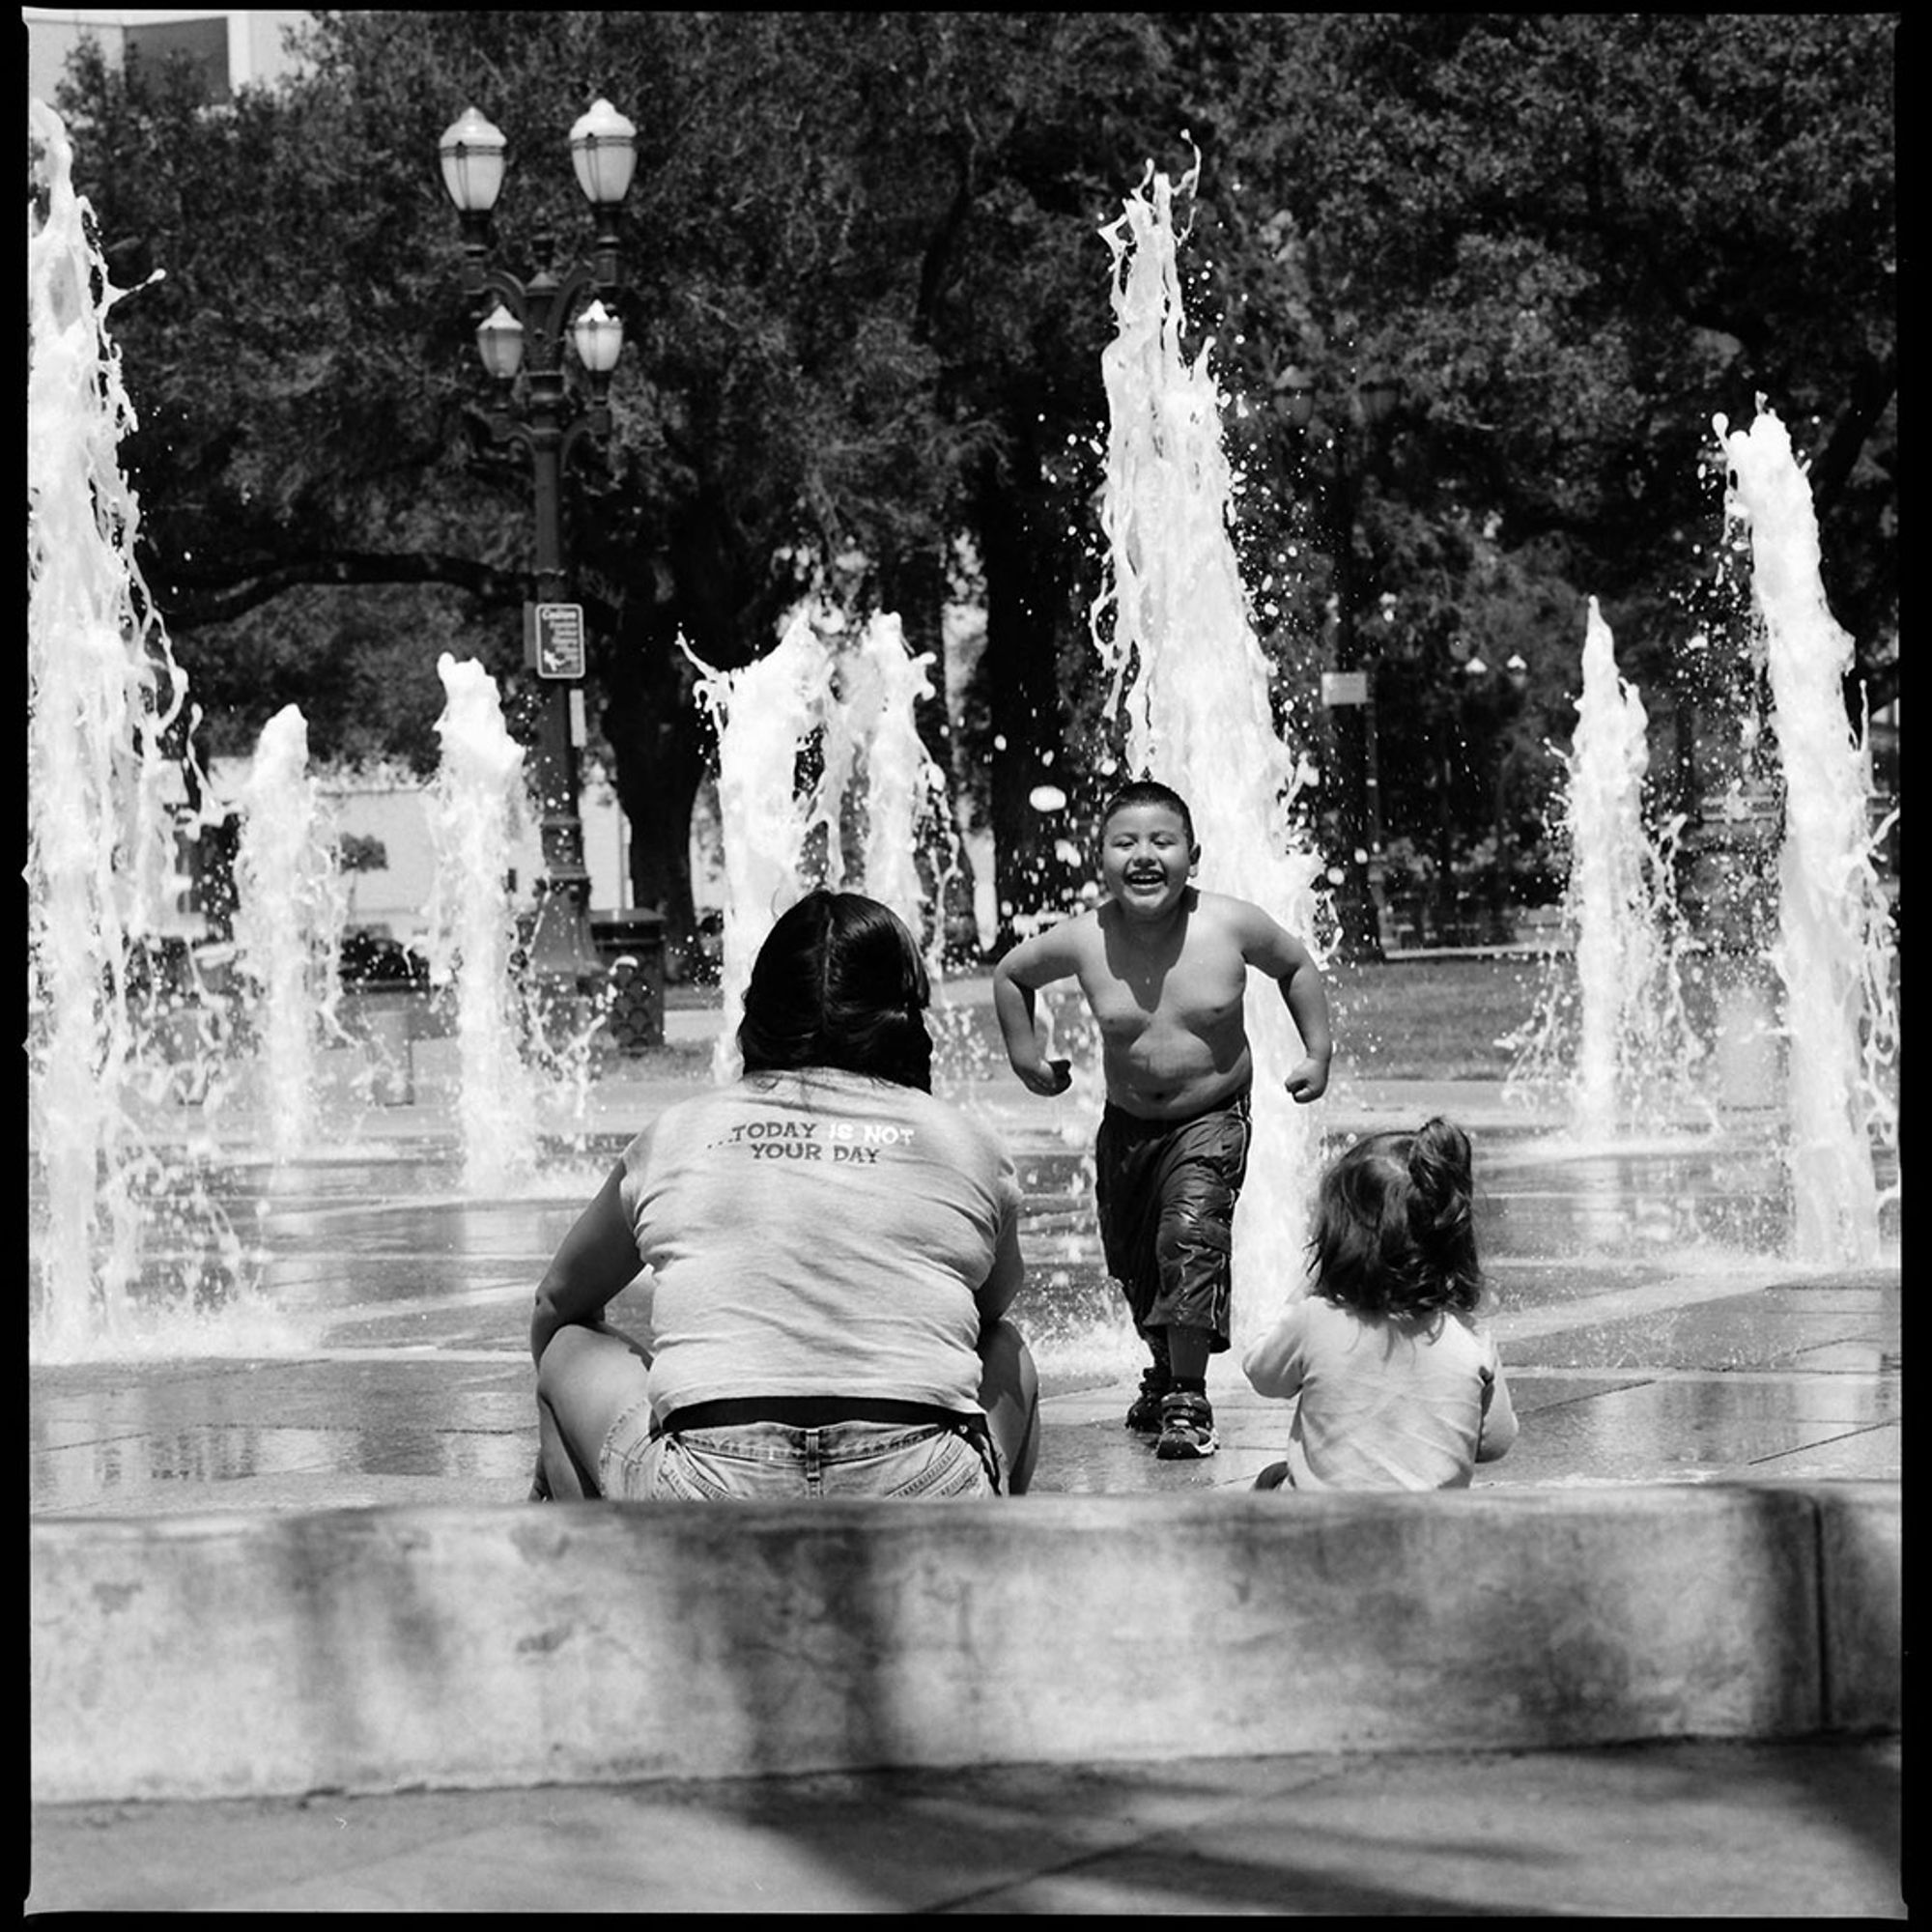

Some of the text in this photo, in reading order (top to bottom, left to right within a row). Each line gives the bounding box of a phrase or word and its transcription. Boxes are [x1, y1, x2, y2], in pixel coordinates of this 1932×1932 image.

[828, 1122, 853, 1141] IS
[864, 1123, 914, 1146] NOT
[750, 1142, 880, 1163] YOUR DAY
